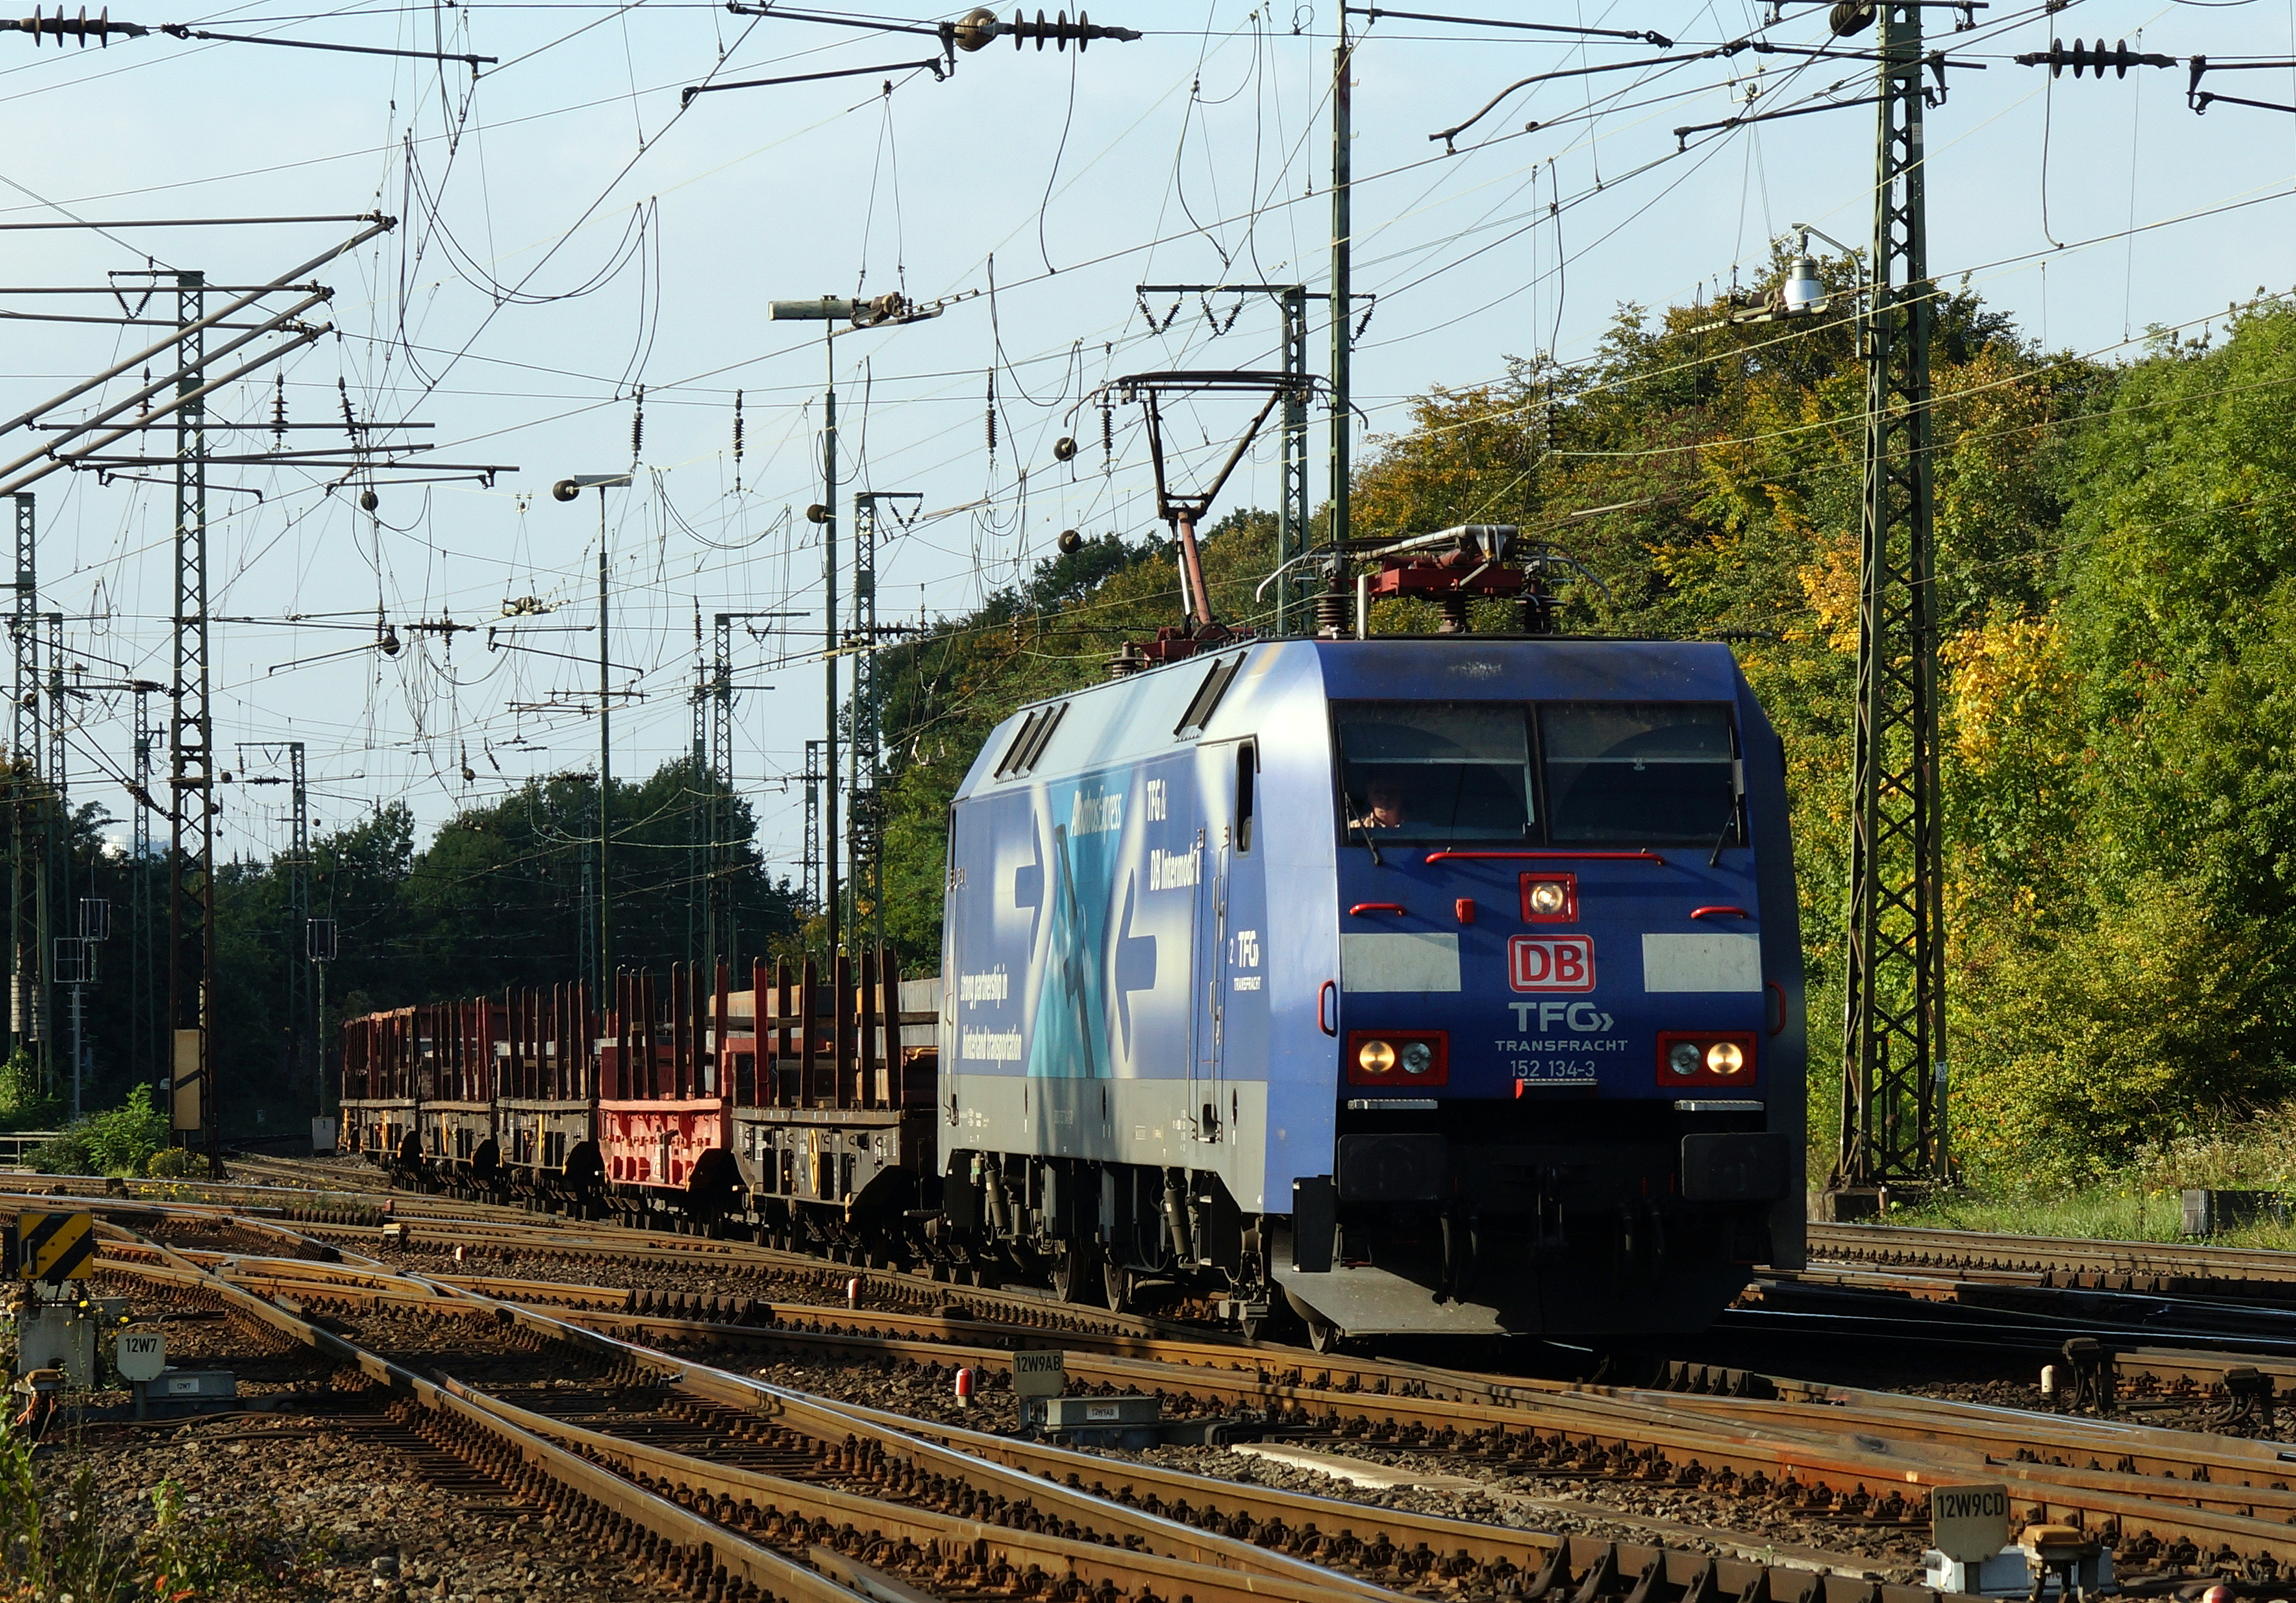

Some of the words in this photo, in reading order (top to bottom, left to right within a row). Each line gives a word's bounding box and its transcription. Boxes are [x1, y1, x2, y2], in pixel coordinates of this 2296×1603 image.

[1147, 778, 1160, 821] TFG
[1150, 849, 1160, 891] DB
[1238, 930, 1258, 967] TFG
[1520, 944, 1584, 982] DB
[1508, 1001, 1605, 1032] TFG
[1495, 1039, 1628, 1052] TRANSFRACHT
[1510, 1060, 1540, 1077] 152
[1548, 1060, 1595, 1077] 134-3
[125, 1337, 157, 1353] 12W7
[1016, 1355, 1061, 1373] 12W9AB
[1092, 1407, 1114, 1417] 12W9AB
[1937, 1493, 2004, 1519] 12W9CD
